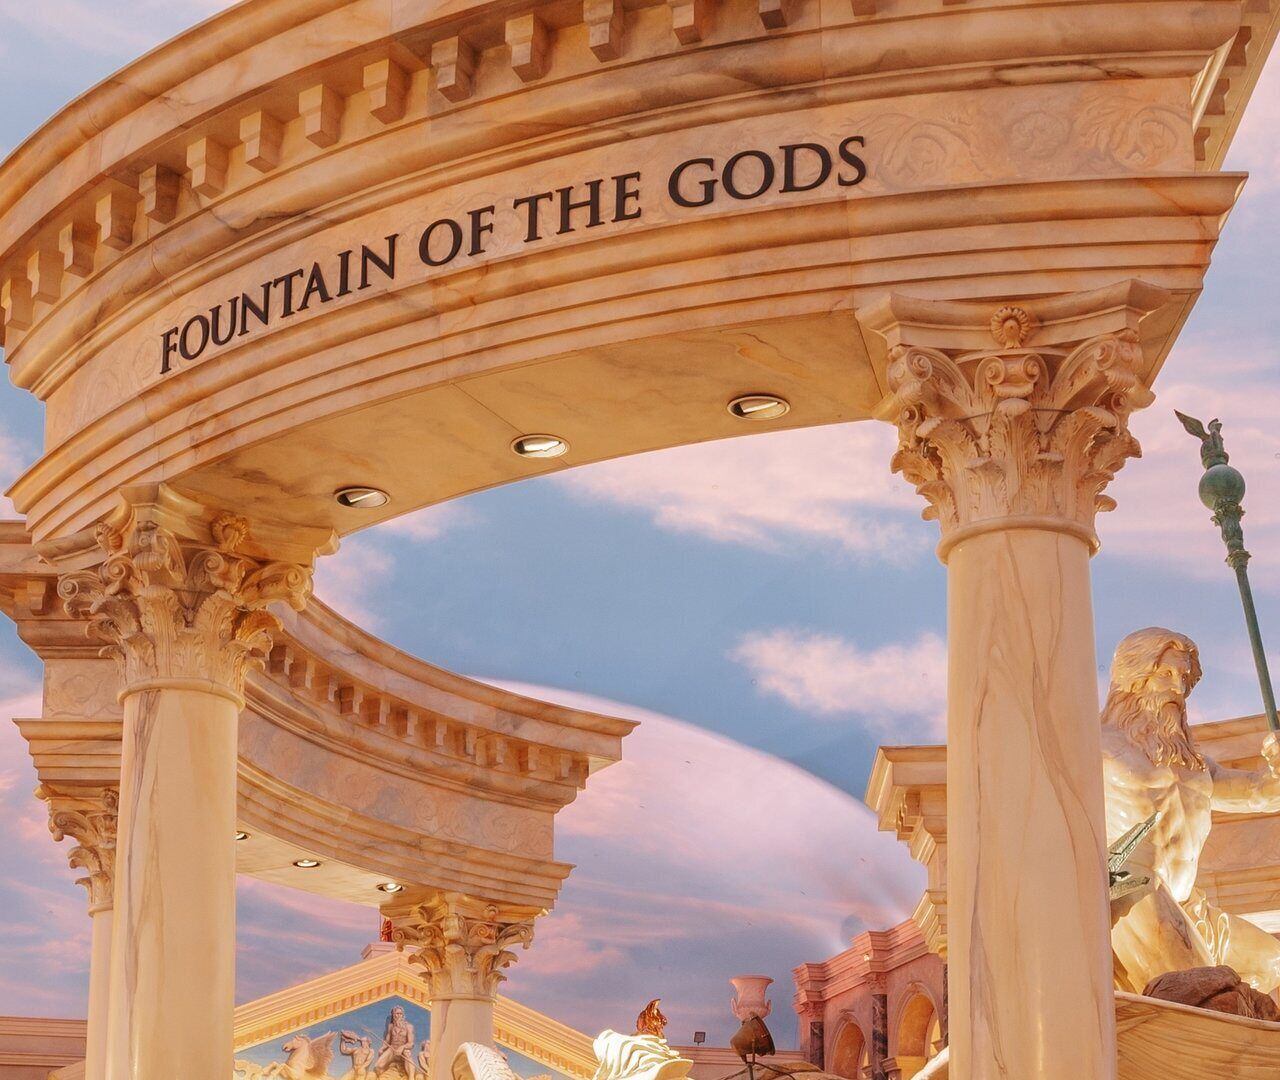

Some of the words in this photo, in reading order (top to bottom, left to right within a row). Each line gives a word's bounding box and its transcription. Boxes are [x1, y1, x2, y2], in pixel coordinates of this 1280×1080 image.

[160, 233, 399, 375] FOUNTAIN
[418, 204, 495, 267] OF
[513, 171, 641, 243] THE
[667, 135, 867, 208] GODS
